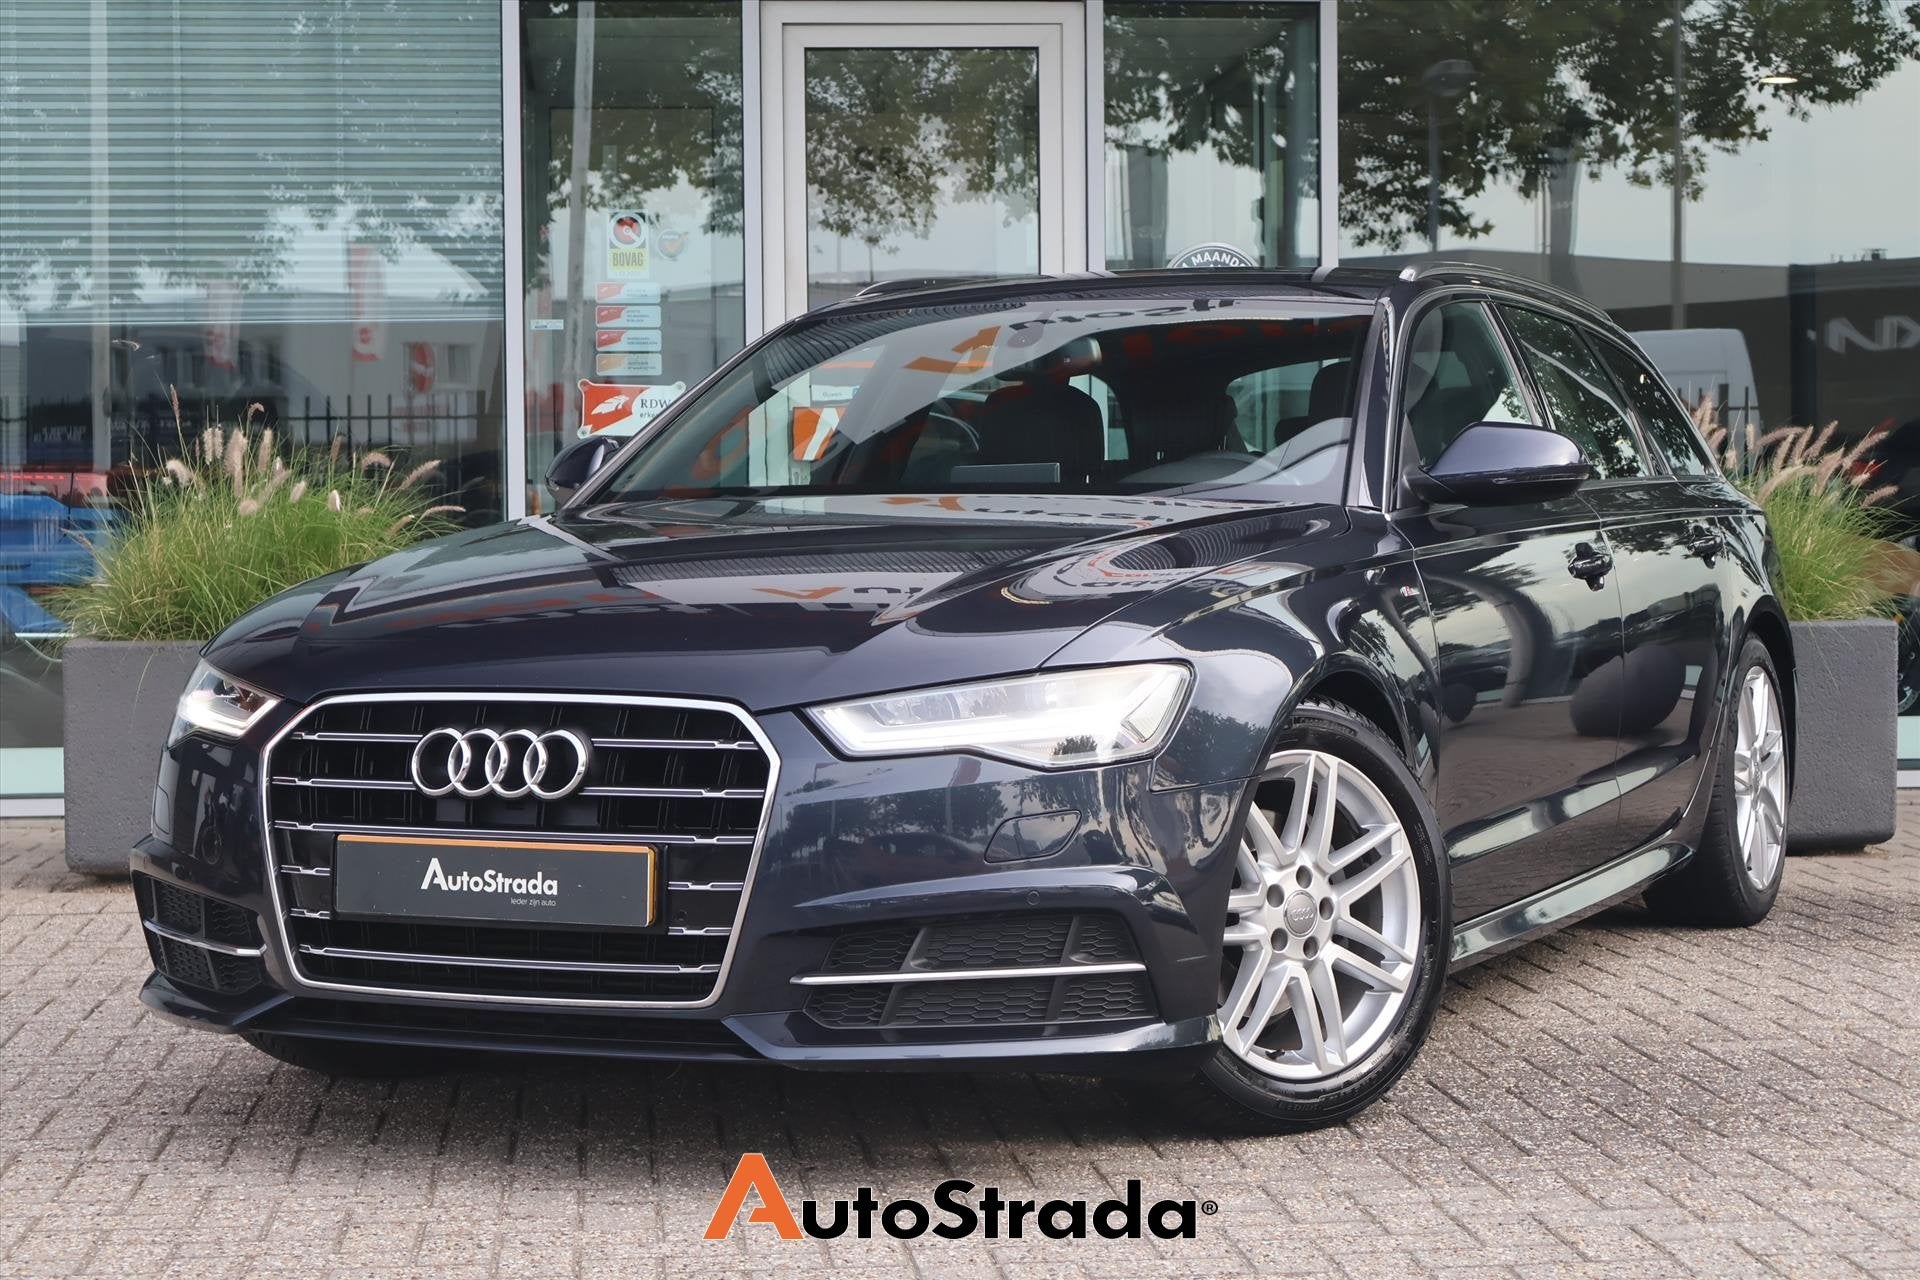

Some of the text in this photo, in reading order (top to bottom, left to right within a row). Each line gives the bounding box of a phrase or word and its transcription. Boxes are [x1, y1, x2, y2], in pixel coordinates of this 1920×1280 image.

[612, 251, 644, 267] BOVAG
[640, 399, 672, 409] RDW
[420, 857, 558, 895] AutoStrada
[541, 899, 557, 907] auto
